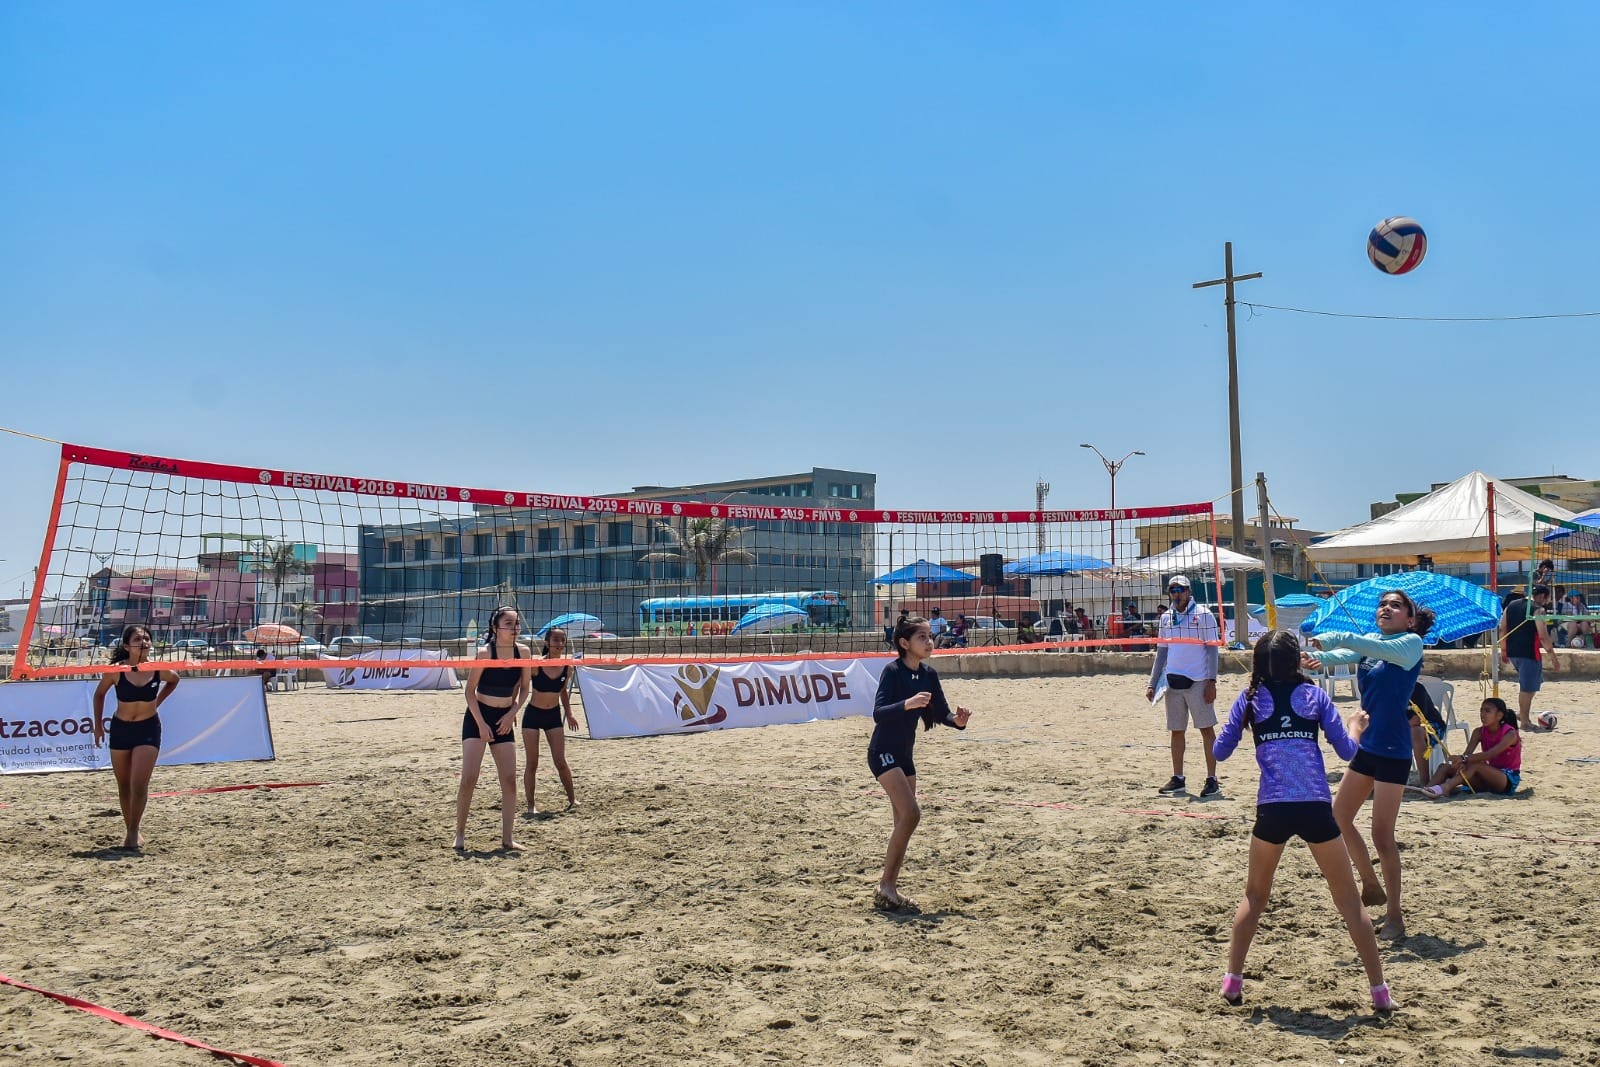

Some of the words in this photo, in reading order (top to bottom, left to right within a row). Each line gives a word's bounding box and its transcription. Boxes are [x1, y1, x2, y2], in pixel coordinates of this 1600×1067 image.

[282, 472, 355, 492] FESTIVAL
[358, 480, 396, 495] 2019
[407, 484, 447, 500] FMVB
[526, 494, 586, 510] FESTIVAL
[588, 499, 618, 512] 2019
[628, 501, 662, 515] FMVB
[728, 507, 777, 519] FESTIVAL
[780, 508, 804, 520] 2019
[812, 511, 841, 521] FMVB
[897, 511, 940, 522] FESTIVAL
[941, 512, 963, 523] 2019
[970, 512, 995, 522] FMVB
[1042, 512, 1077, 522] FESTIVAL
[1080, 511, 1099, 521] 2019
[732, 672, 850, 707] DIMUDE
[1280, 715, 1292, 728] 2
[1260, 731, 1314, 741] VERACRUZ
[34, 745, 52, 756] que
[880, 752, 895, 767] 10
